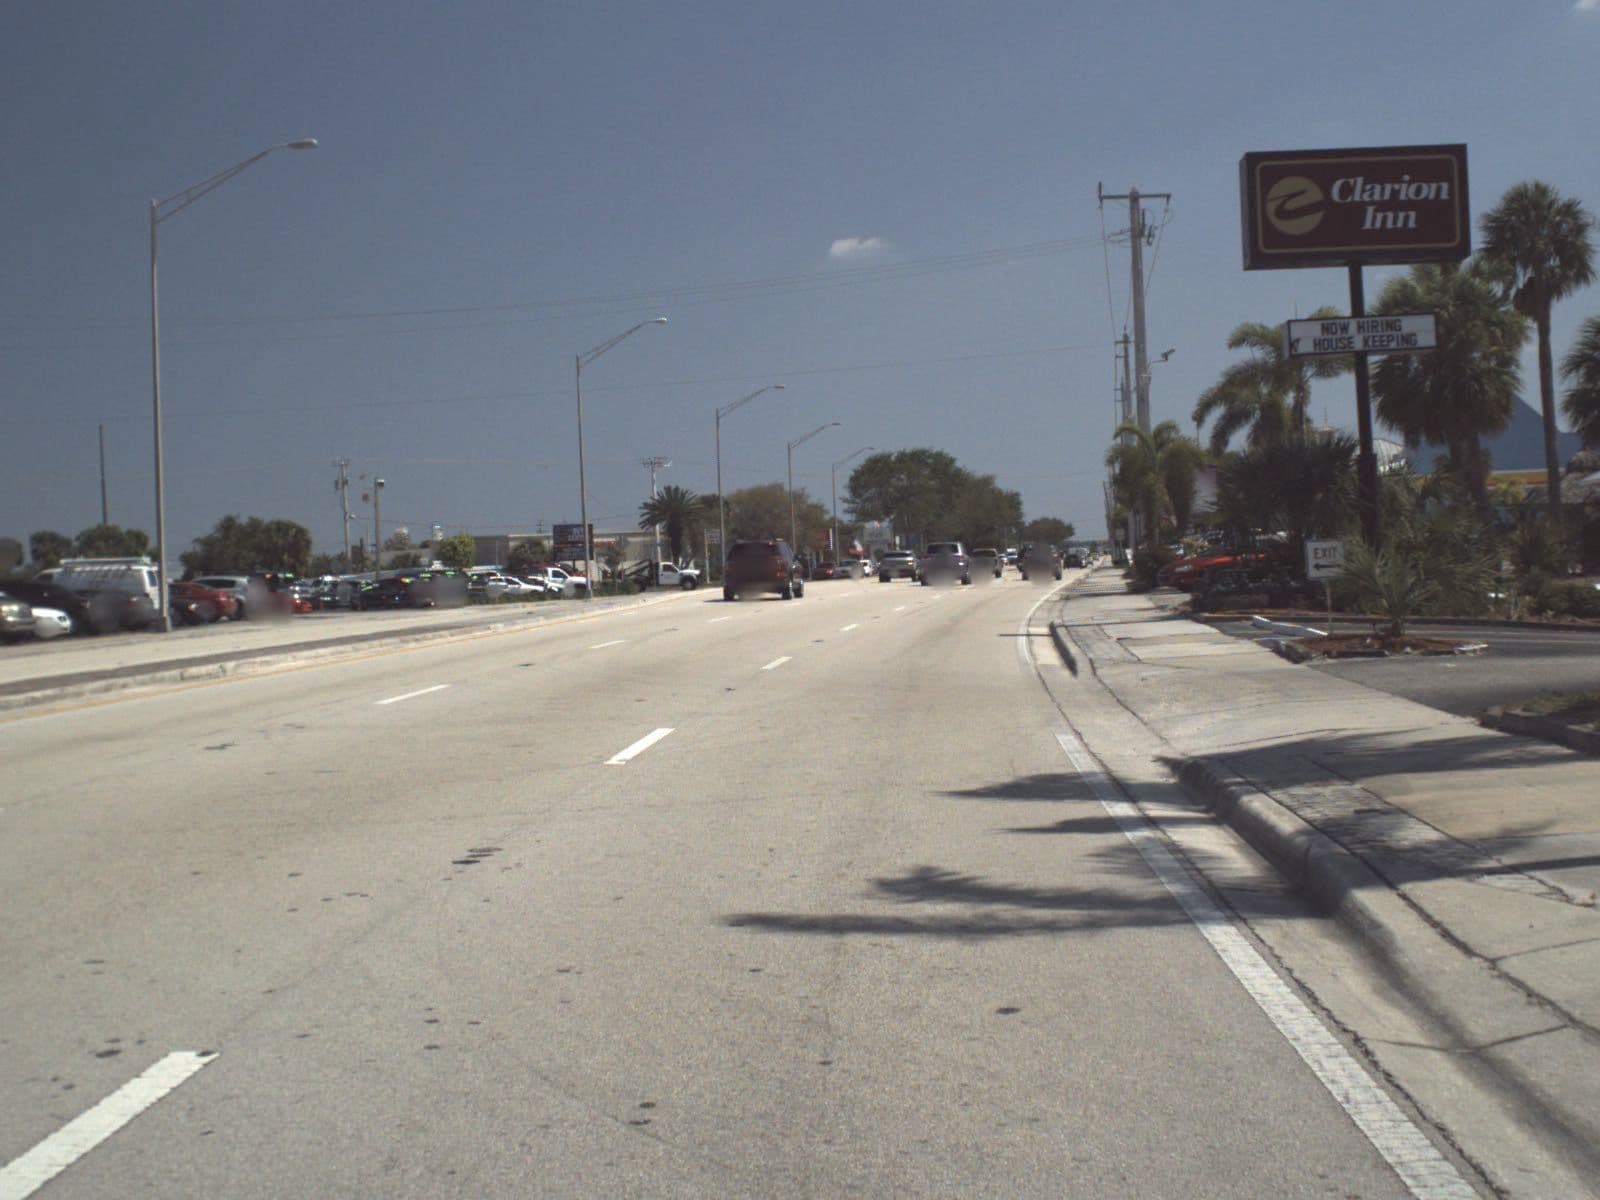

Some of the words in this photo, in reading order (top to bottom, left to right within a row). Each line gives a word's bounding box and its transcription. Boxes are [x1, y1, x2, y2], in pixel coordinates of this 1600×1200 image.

[1331, 175, 1450, 202] Clarion
[1361, 205, 1417, 230] Inn
[1320, 321, 1350, 337] NOW
[1356, 318, 1402, 335] HIRING
[1312, 336, 1355, 351] HOUSE
[1363, 332, 1418, 349] KEEPING
[1313, 547, 1338, 560] EXIT
